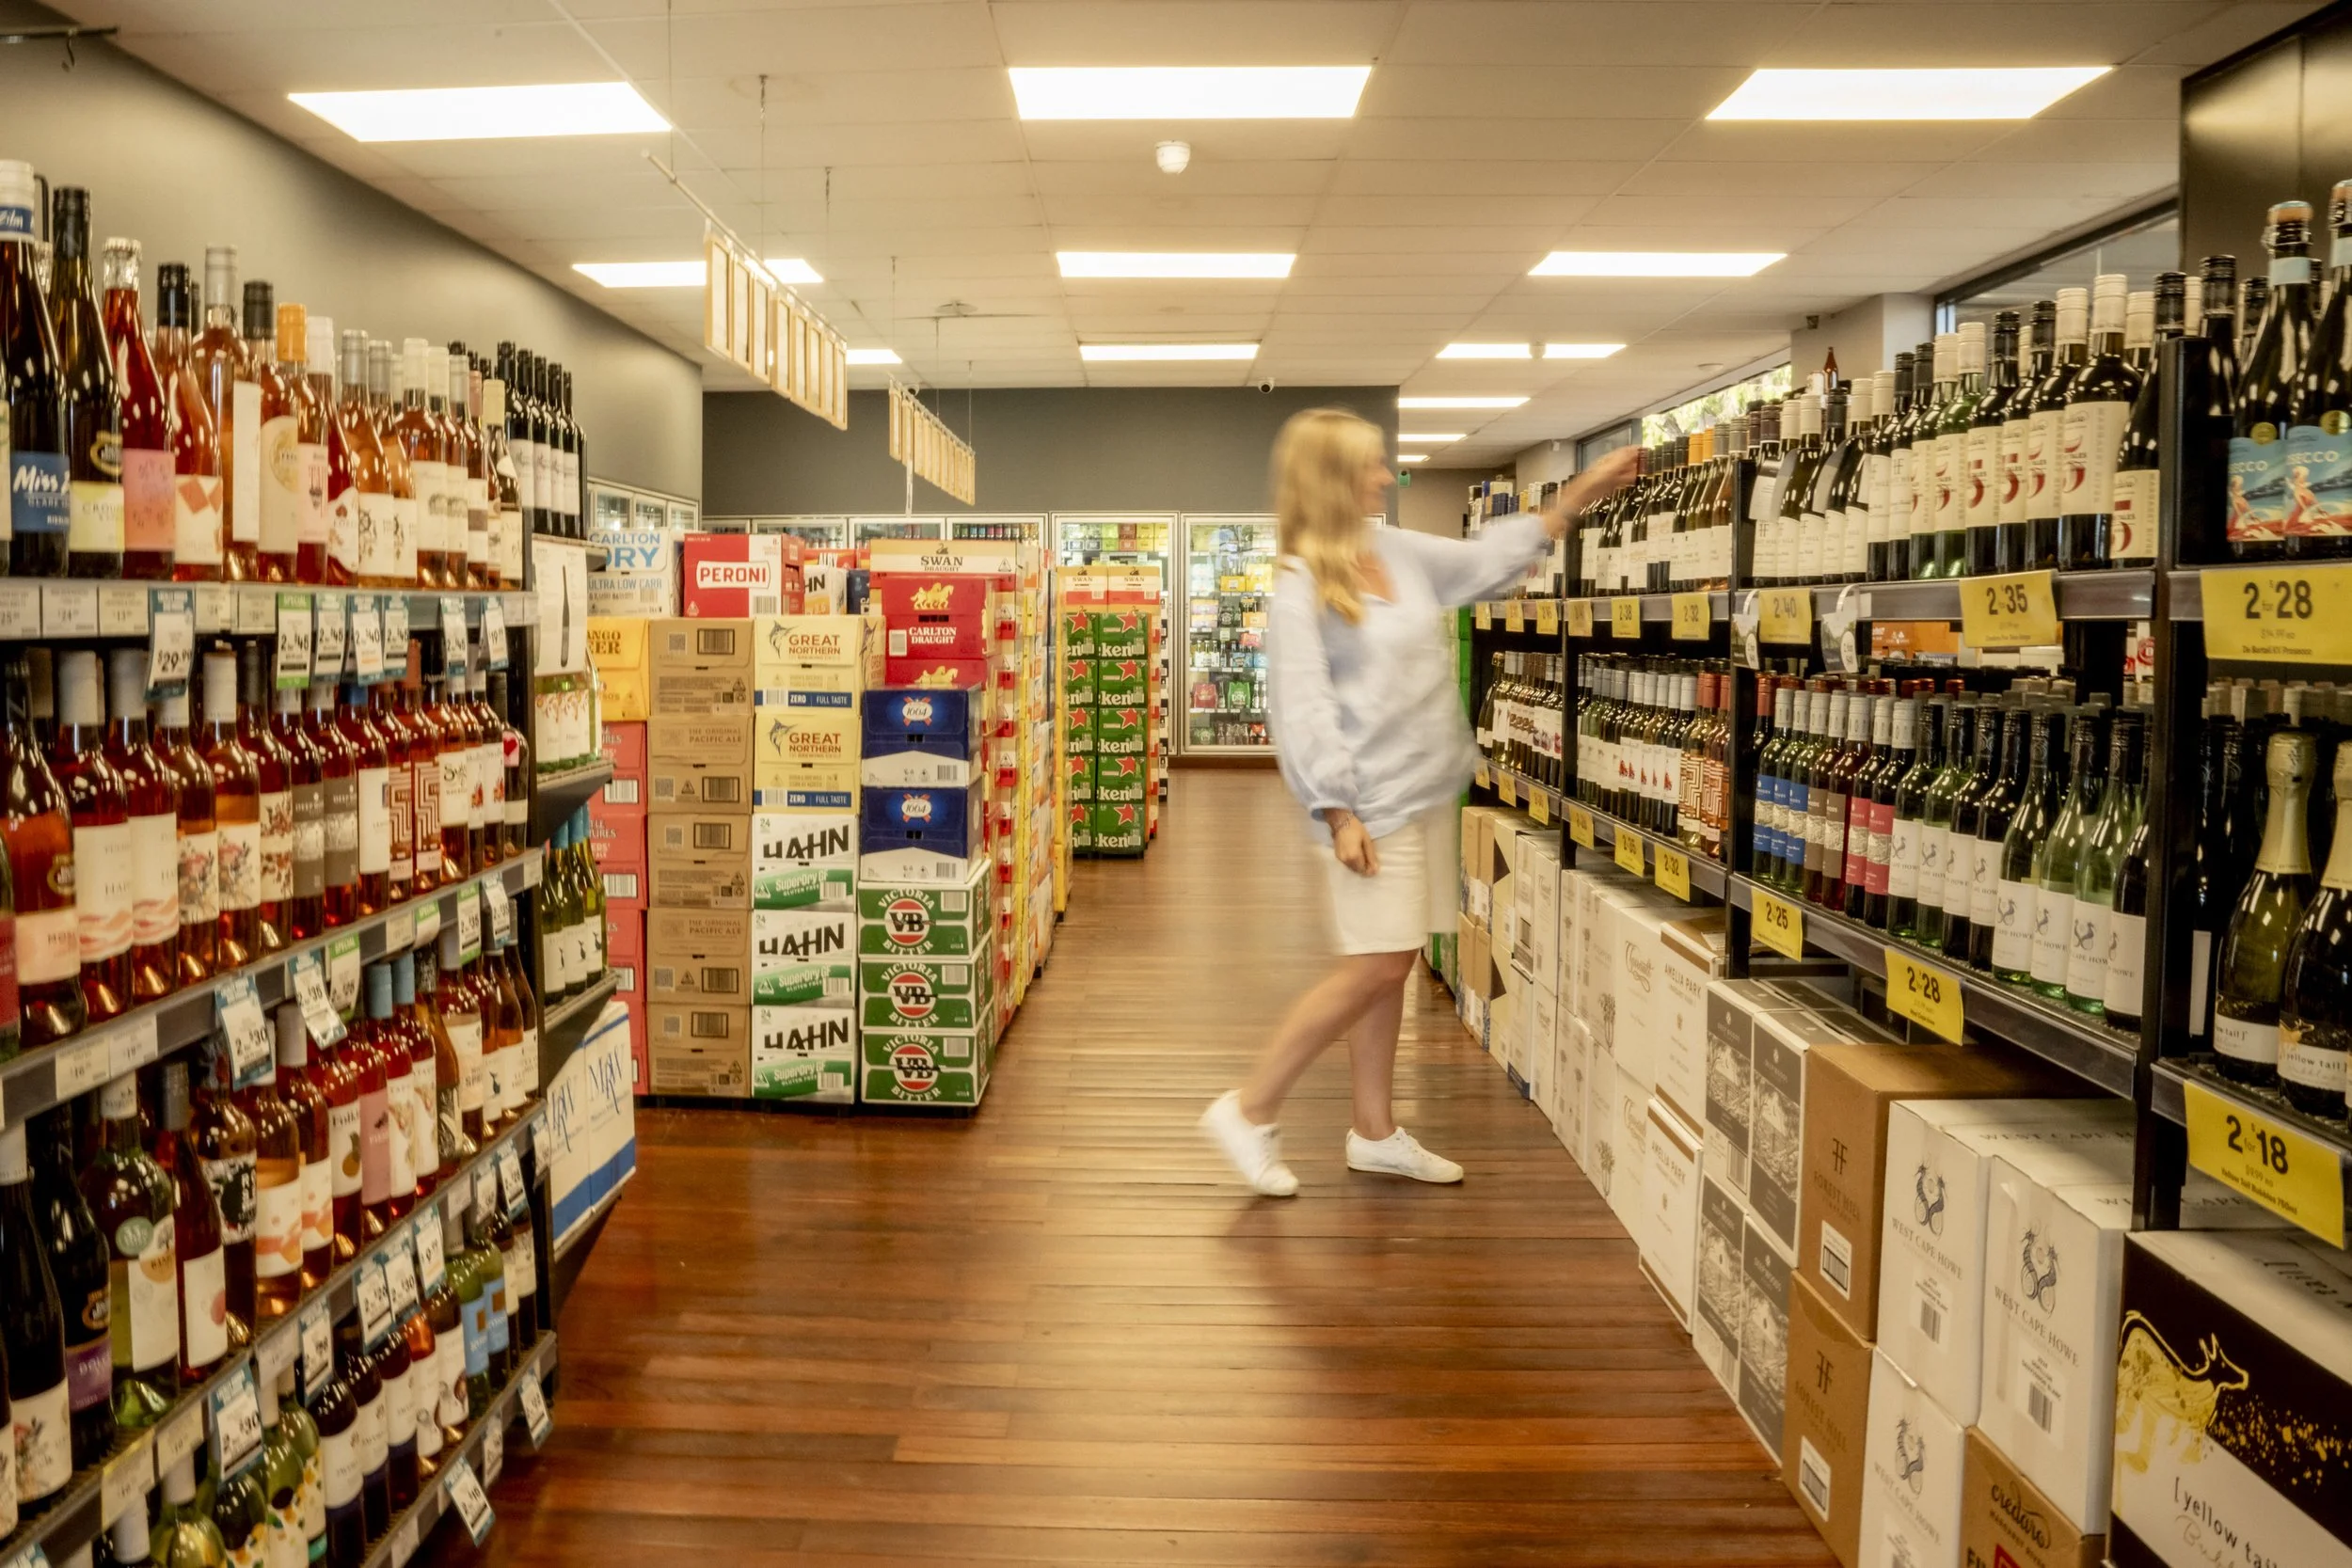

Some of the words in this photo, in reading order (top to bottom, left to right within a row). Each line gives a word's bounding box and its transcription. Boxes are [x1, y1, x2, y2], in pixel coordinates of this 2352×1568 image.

[590, 532, 660, 545] CARLTON
[606, 547, 659, 568] RY
[920, 556, 963, 566] SWAN
[700, 567, 767, 582] PERONI
[617, 579, 636, 590] LOW
[1987, 587, 1998, 615] 2
[2243, 582, 2262, 619] 2
[587, 630, 621, 641] ANGO
[788, 634, 840, 646] GREAT
[909, 626, 957, 637] CARLTON
[911, 636, 956, 644] DRAUGHT
[587, 641, 621, 654] EER
[789, 646, 840, 655] NORTHERN
[790, 694, 806, 703] ZERO
[789, 733, 841, 744] GREAT
[789, 744, 841, 752] NORTHERN
[789, 795, 805, 803] ZERO
[816, 796, 828, 804] FULL
[831, 796, 846, 804] TASTE
[878, 888, 935, 911] VICTORIA
[1766, 902, 1772, 922] 2
[889, 911, 925, 932] VB
[882, 939, 934, 957] BITTER
[881, 961, 938, 984] VICTORIA
[1664, 963, 1684, 986] AMELIA
[1685, 978, 1701, 999] PARK
[1907, 966, 1916, 992] 2
[892, 986, 930, 1006] VB
[888, 1011, 940, 1028] BITTER
[882, 1033, 940, 1054] VICTORIA
[891, 1085, 942, 1102] BITTER
[2226, 1115, 2243, 1153] 2
[1891, 1216, 1914, 1241] WEST
[1915, 1235, 1936, 1259] CAPE
[1937, 1251, 1963, 1280] HOWE
[1994, 1285, 2020, 1315] WEST
[2022, 1309, 2045, 1338] CAPE
[2048, 1331, 2079, 1369] HOWE
